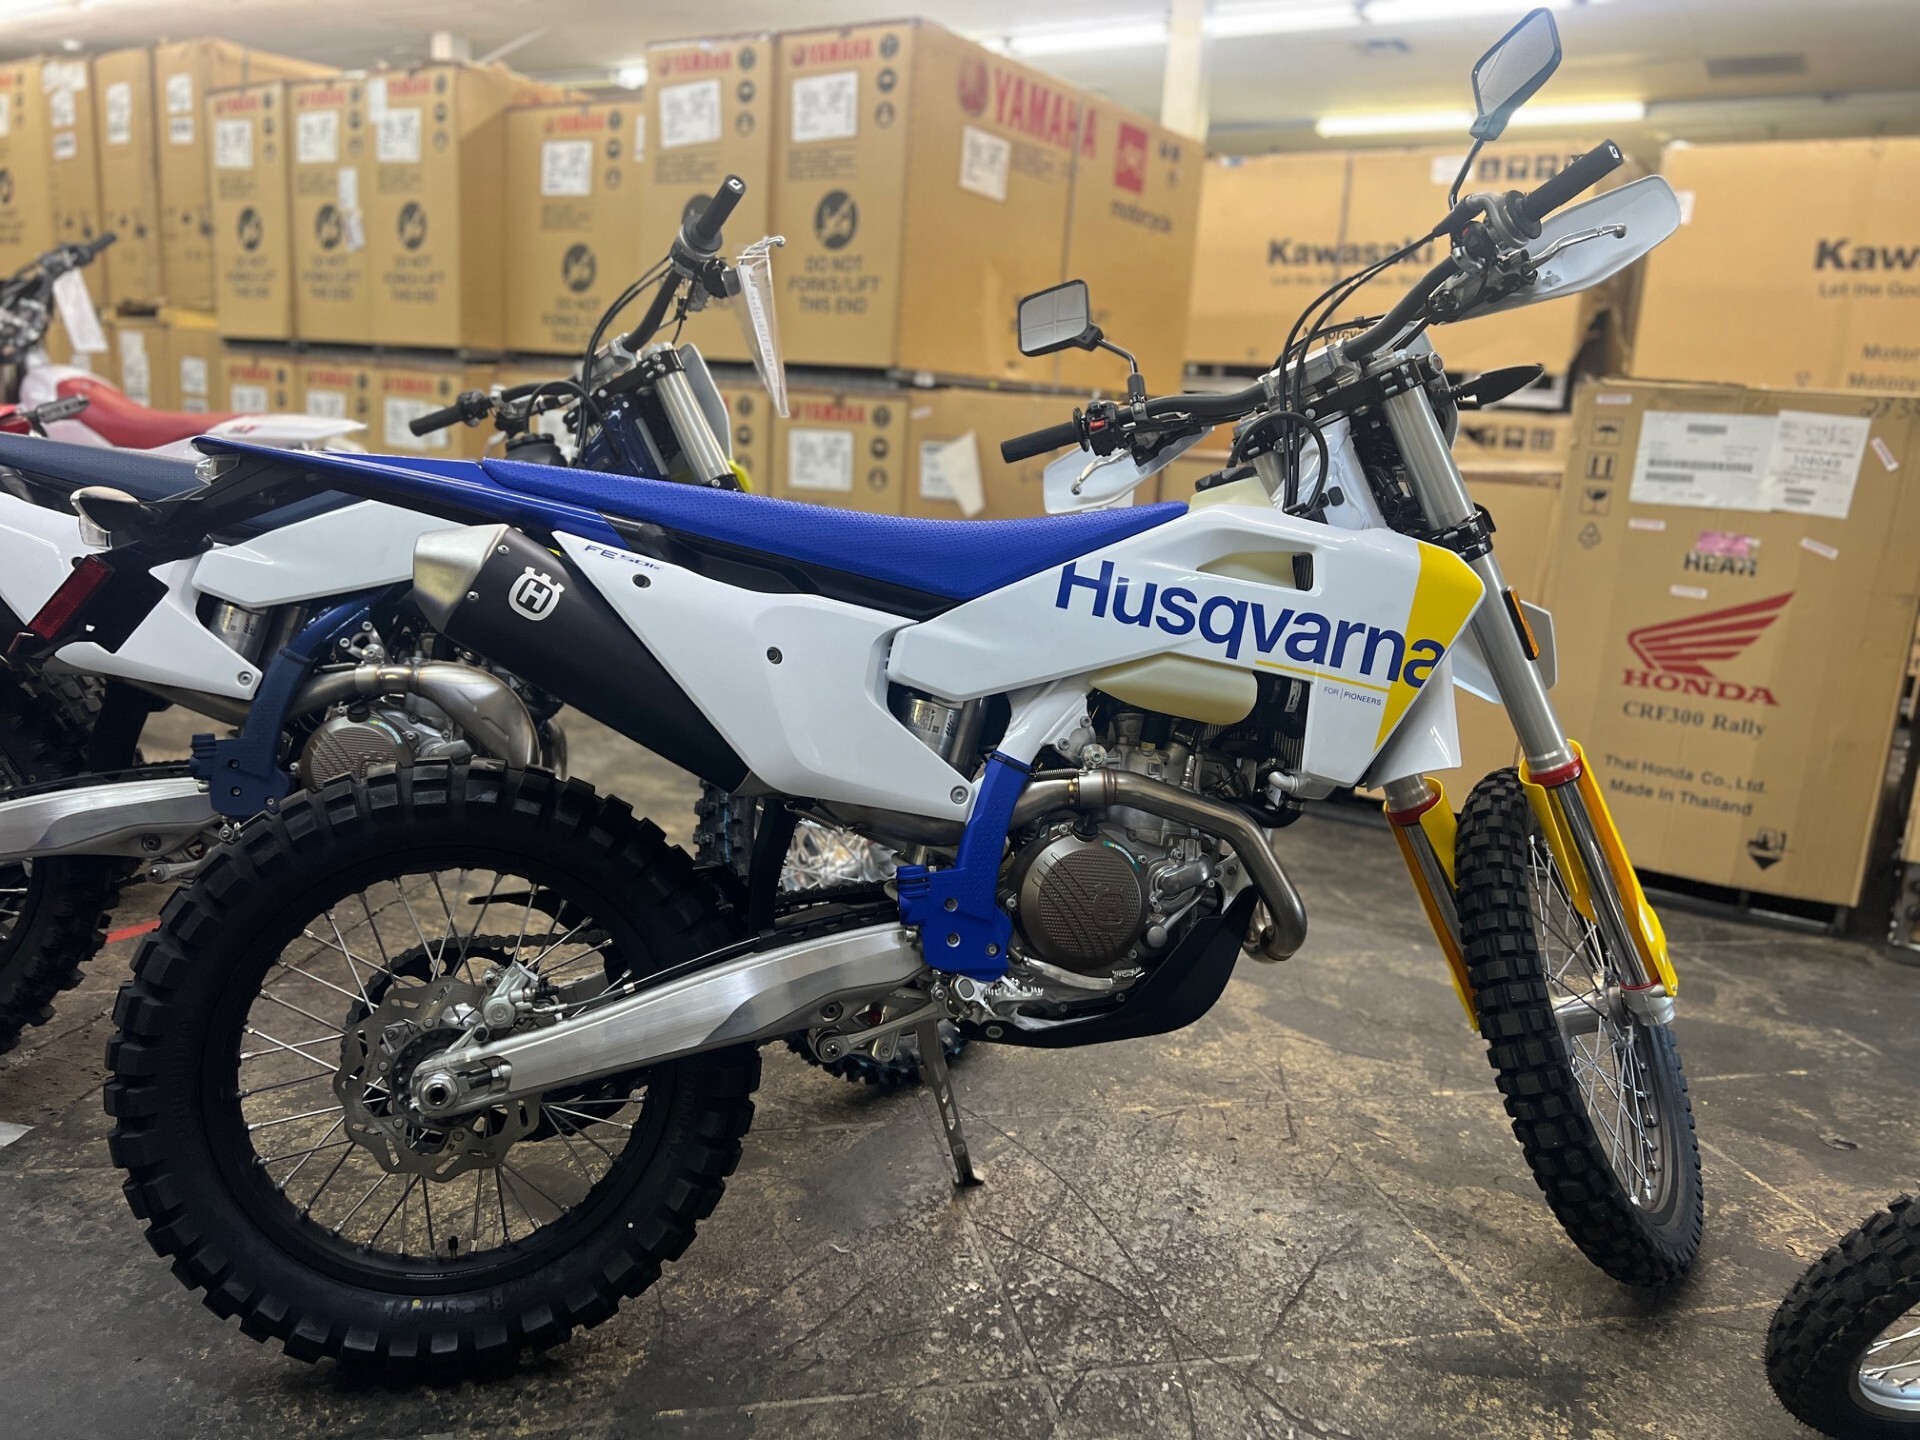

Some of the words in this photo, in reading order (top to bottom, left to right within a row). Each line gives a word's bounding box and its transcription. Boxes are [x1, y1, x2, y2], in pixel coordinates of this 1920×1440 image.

[995, 65, 1097, 161] YAMAHA
[804, 256, 832, 273] DO
[836, 255, 864, 273] NOT
[584, 545, 618, 560] FE
[1055, 560, 1446, 688] Husqvarna
[1323, 686, 1340, 696] FOR
[1343, 691, 1382, 706] PIONEERS
[1621, 668, 1780, 707] HONDA
[1622, 700, 1705, 726] CRF300
[1711, 713, 1766, 741] Rally
[1604, 753, 1638, 771] Thai
[1640, 761, 1694, 781] Honda
[1609, 778, 1653, 798] Made
[1658, 787, 1675, 803] in
[1679, 790, 1754, 817] Thailand
